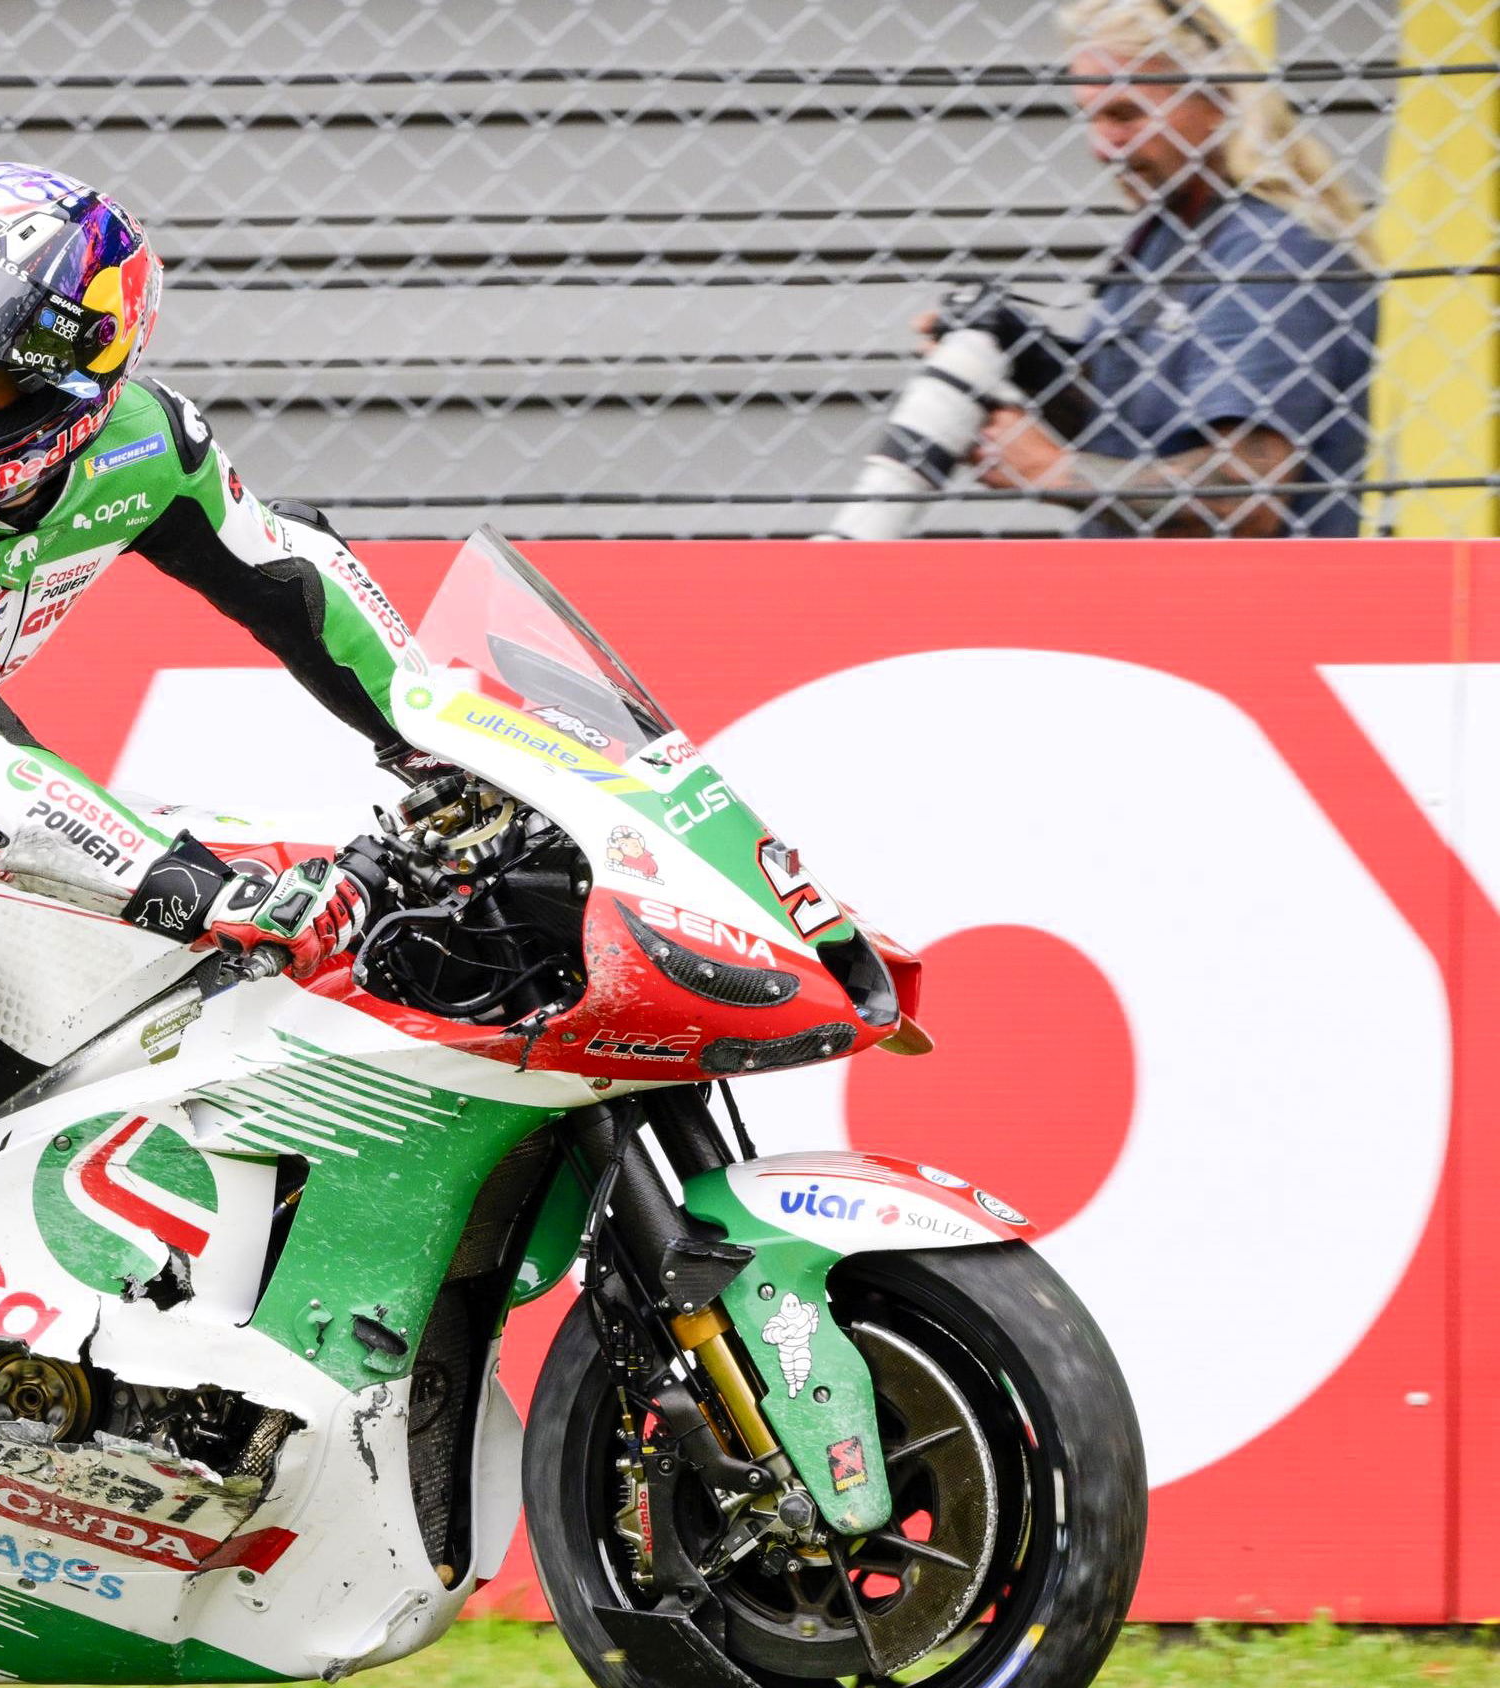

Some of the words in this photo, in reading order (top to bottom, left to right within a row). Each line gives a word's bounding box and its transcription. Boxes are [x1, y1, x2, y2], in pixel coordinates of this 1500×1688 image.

[50, 294, 84, 316] SHARK
[52, 323, 77, 342] LOCK
[24, 351, 56, 367] april
[109, 441, 158, 466] MICHELIN
[95, 492, 152, 523] april
[126, 516, 148, 527] Moto
[40, 571, 97, 603] POWER1
[46, 557, 101, 587] Castrol
[465, 711, 580, 767] ultimate
[45, 779, 146, 855] Castrol
[26, 800, 135, 877] POWER1
[639, 898, 777, 968] SENA
[585, 1028, 701, 1057] HRC
[780, 1184, 866, 1222] viar
[904, 1211, 976, 1242] SOLIZE
[639, 1490, 653, 1555] brembo
